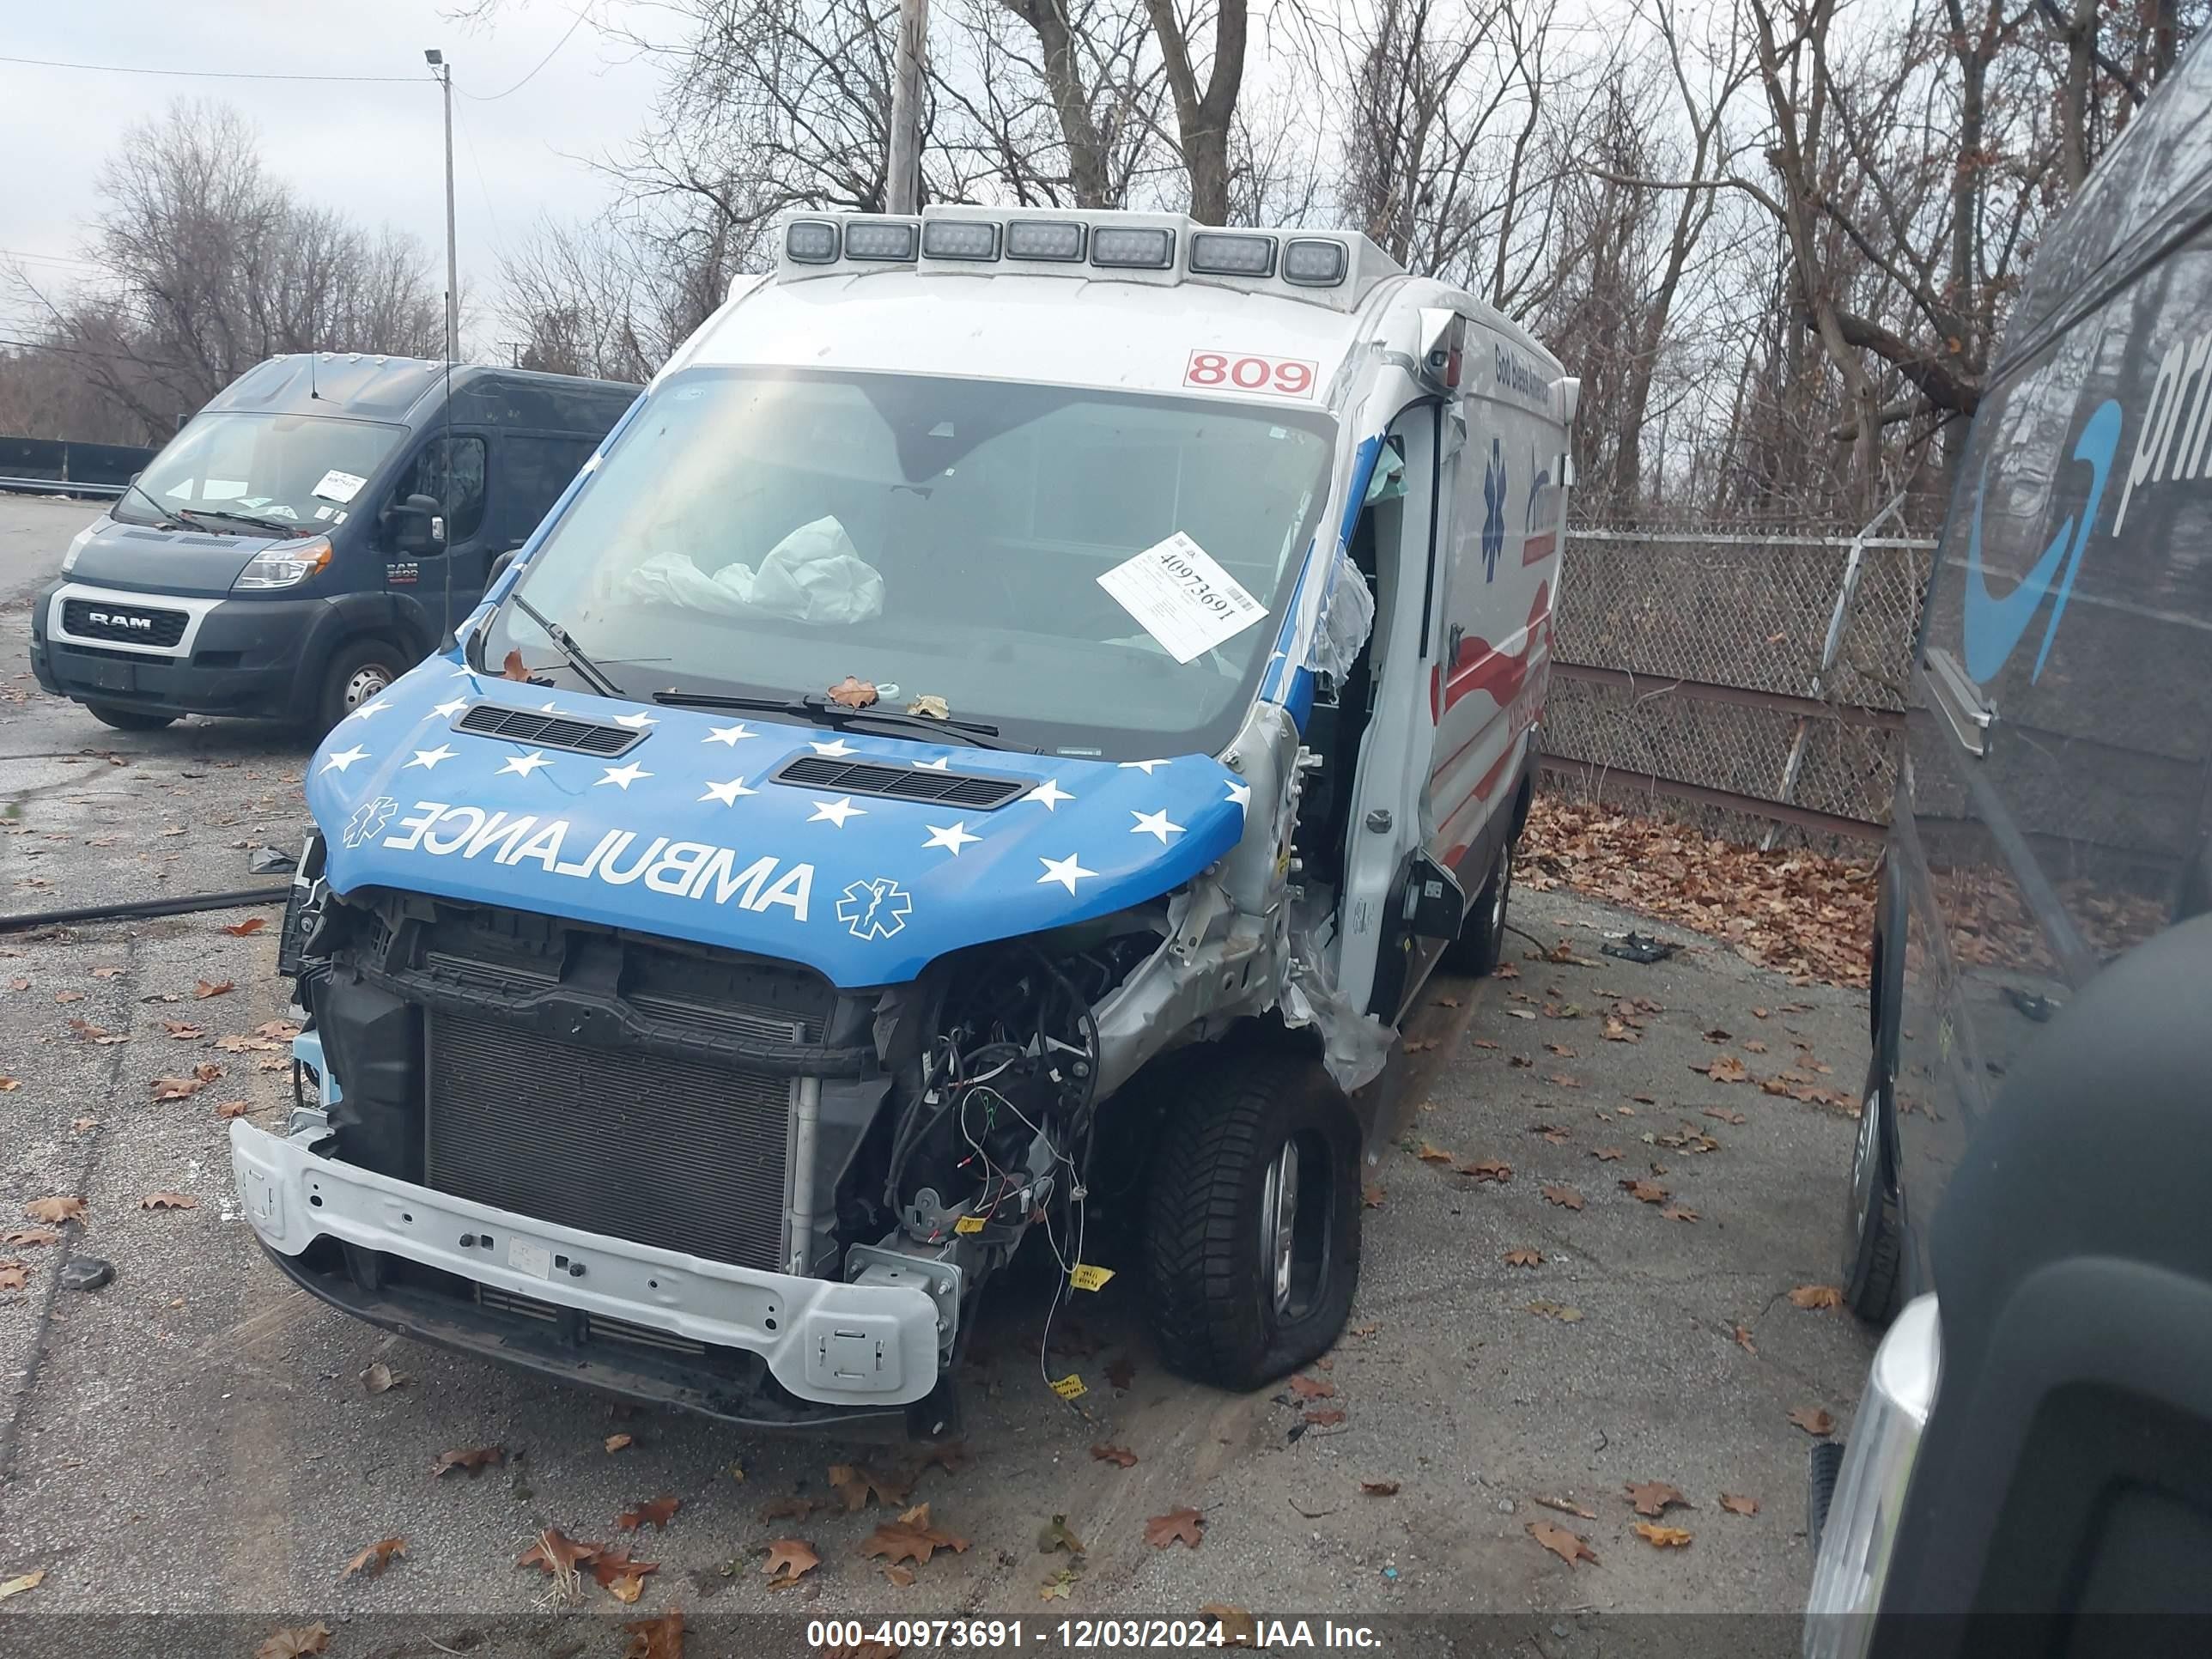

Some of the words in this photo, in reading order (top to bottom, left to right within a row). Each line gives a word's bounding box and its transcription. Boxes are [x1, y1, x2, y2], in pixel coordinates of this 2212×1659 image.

[1190, 355, 1310, 392] 809
[1495, 343, 1510, 386] God
[1160, 552, 1236, 622] 40973691
[89, 612, 152, 629] RAM
